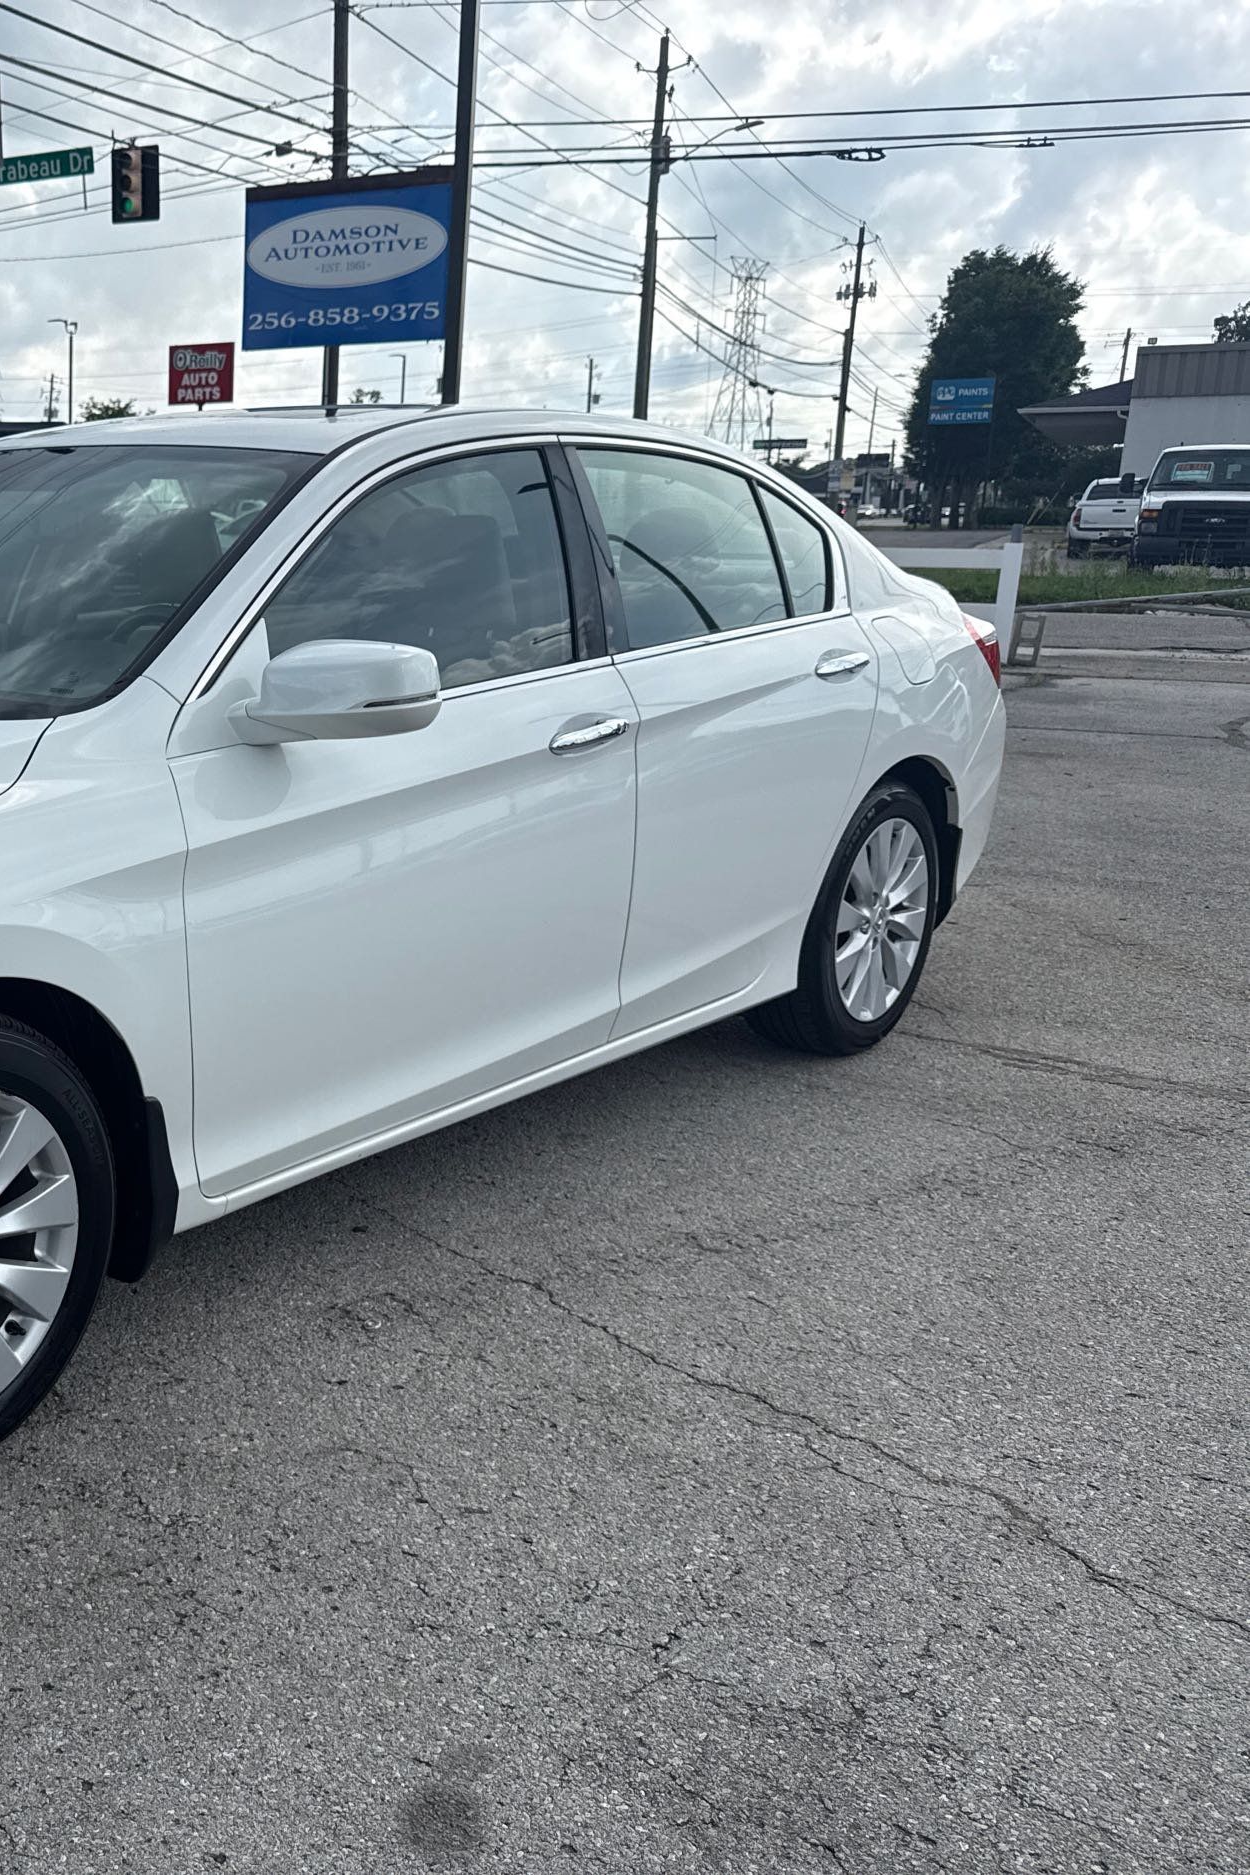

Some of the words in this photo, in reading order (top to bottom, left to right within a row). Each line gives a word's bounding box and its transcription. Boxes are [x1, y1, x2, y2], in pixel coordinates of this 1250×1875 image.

[69, 152, 91, 173] Dr
[292, 223, 399, 244] DAMSON
[264, 237, 428, 262] AUTOMOTIVE
[248, 302, 440, 331] 256-858-9375
[173, 349, 227, 371] O'Reilly
[181, 372, 218, 387] AUTO
[177, 387, 221, 402] PARTS
[958, 387, 989, 397] PAINTS
[930, 412, 954, 421] PAINT
[955, 411, 989, 420] CENTER
